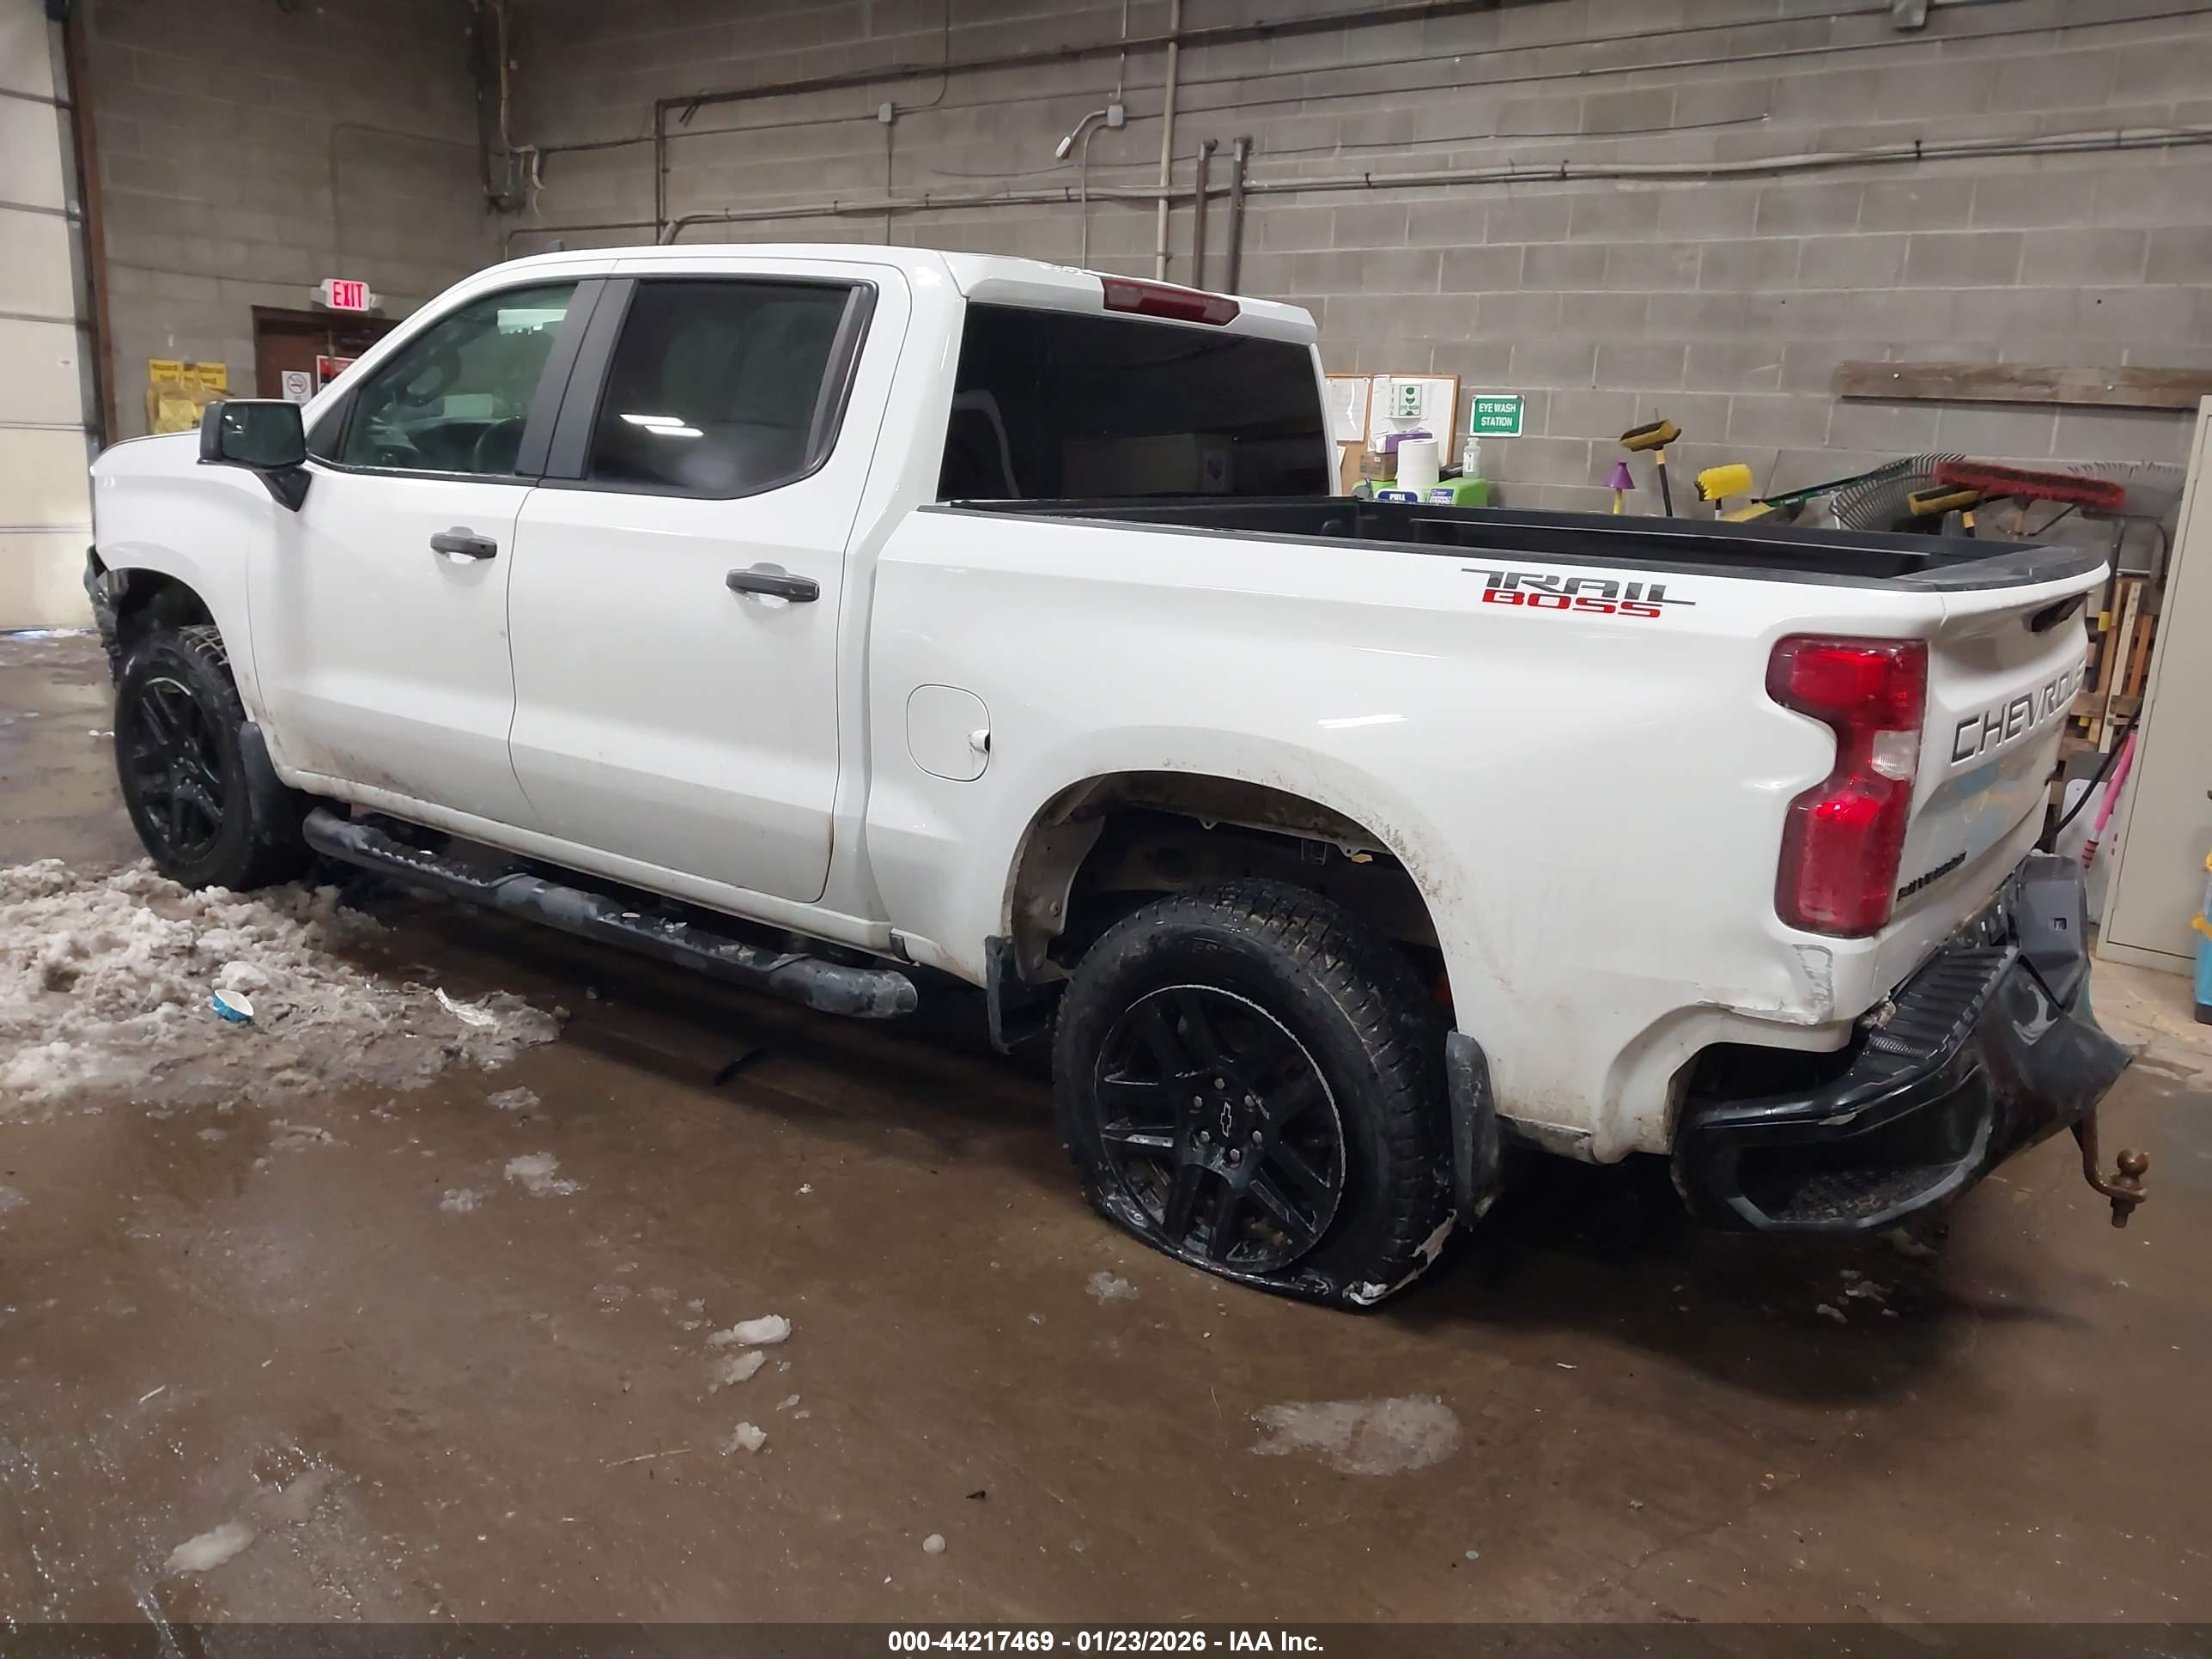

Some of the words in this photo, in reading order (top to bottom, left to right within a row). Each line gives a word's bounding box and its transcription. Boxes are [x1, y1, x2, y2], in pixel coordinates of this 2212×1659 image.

[333, 281, 363, 308] EXIT
[1479, 403, 1493, 413] EYE
[1494, 403, 1516, 413] WASH
[1480, 416, 1513, 427] STATION
[1461, 568, 1696, 606] TRAIL
[1482, 588, 1663, 618] BOSS
[1951, 655, 2087, 766] CHEVROLE
